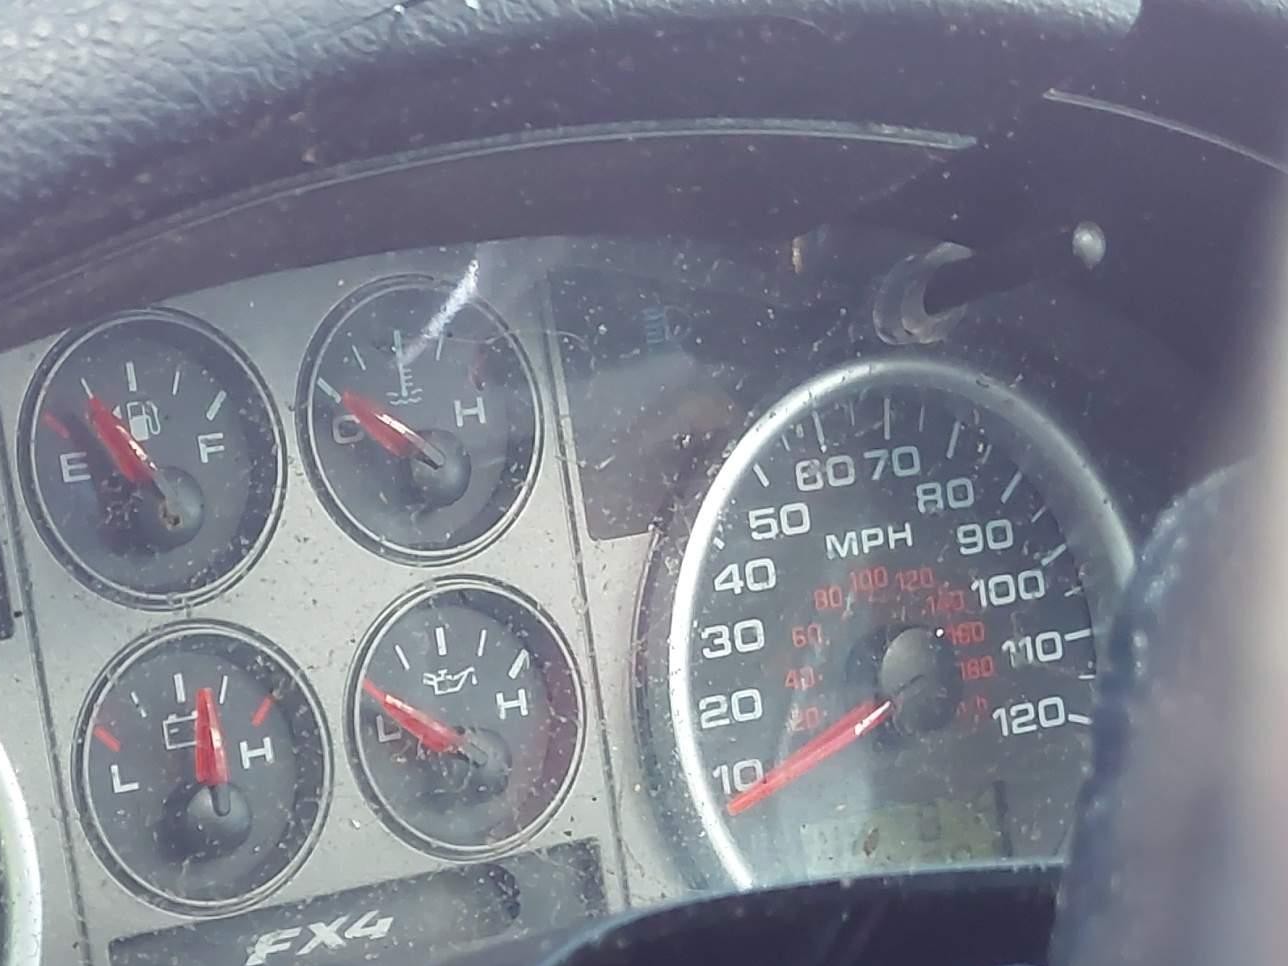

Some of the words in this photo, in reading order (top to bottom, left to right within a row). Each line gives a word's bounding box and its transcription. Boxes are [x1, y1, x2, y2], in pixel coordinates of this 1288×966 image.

[332, 414, 365, 444] C
[455, 397, 486, 427] H
[197, 433, 226, 463] F
[863, 445, 921, 482] 70
[59, 452, 91, 483] E
[795, 455, 855, 492] 60
[915, 477, 975, 513] 80
[748, 502, 811, 541] 50
[957, 519, 1014, 555] 90
[825, 522, 914, 560] MPH
[713, 558, 777, 595] 40
[850, 566, 888, 593] 100
[896, 567, 934, 592] 120
[971, 569, 1046, 608] 100
[700, 619, 765, 659] 30
[1001, 631, 1063, 667] 110
[496, 689, 529, 720] H
[698, 689, 762, 728] 20
[992, 696, 1065, 736] 120
[240, 737, 275, 769] H
[111, 765, 140, 794] L
[713, 759, 765, 795] 10
[244, 911, 394, 966] FX4
